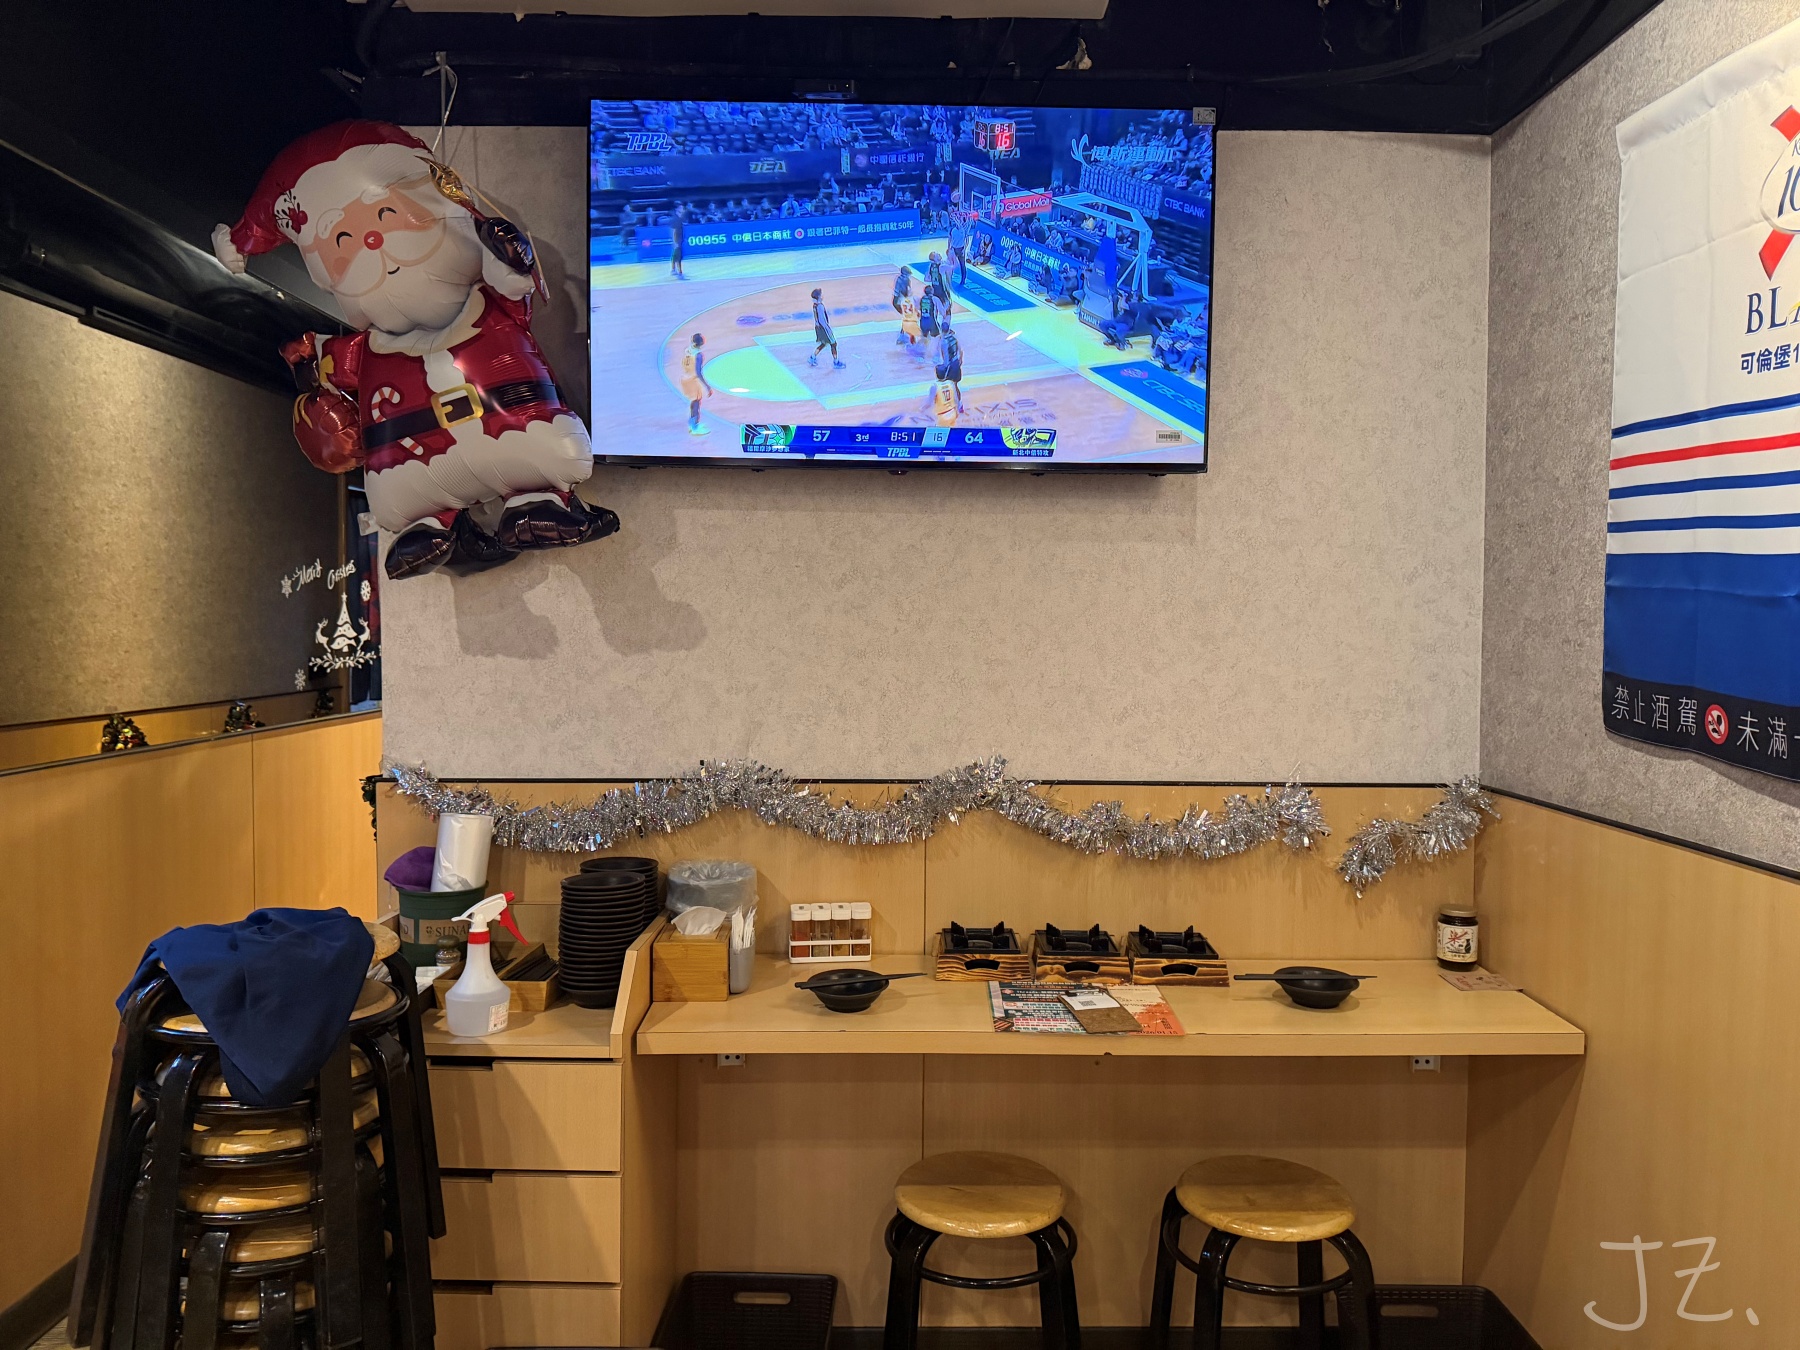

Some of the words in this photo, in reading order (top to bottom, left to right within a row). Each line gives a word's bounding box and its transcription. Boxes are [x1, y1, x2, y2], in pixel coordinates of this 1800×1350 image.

[1005, 199, 1032, 212] Global
[1164, 197, 1183, 212] CTBC
[1183, 203, 1206, 219] BANK
[688, 233, 727, 246] 00955
[813, 430, 831, 442] 57
[855, 433, 869, 442] 3rd
[890, 431, 916, 442] 8:51
[933, 432, 943, 442] 16
[964, 431, 984, 444] 64
[887, 447, 911, 458] TPBL
[1611, 683, 1698, 737] 禁止酒駕
